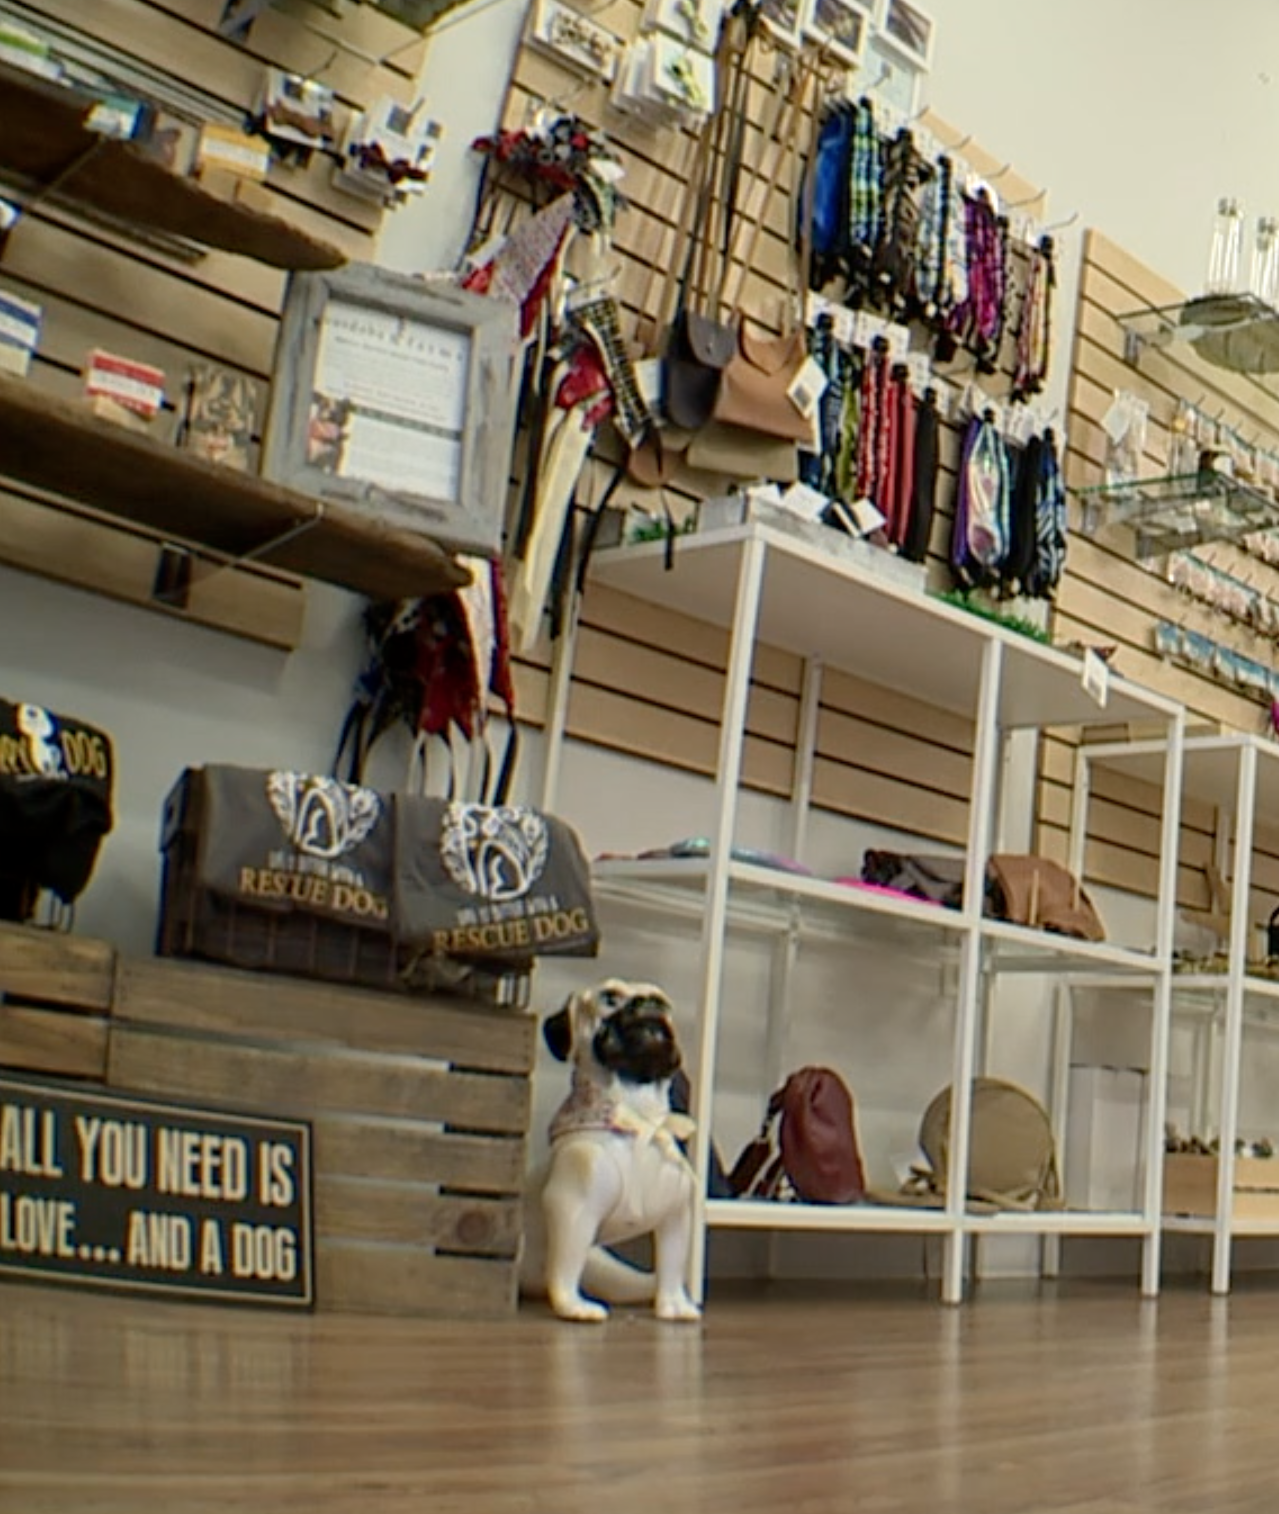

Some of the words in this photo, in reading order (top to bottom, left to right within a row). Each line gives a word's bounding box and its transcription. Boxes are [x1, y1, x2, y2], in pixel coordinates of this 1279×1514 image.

[61, 730, 108, 778] DOG
[240, 866, 330, 905] RESUE
[432, 918, 531, 956] RESCUE
[533, 906, 590, 941] DOG
[0, 1104, 63, 1178] ALL
[75, 1115, 147, 1189] YOU
[157, 1126, 247, 1201] NEED
[259, 1141, 294, 1207] IS
[0, 1192, 122, 1263] LOVE...
[127, 1210, 191, 1271] AND
[201, 1218, 223, 1275] A
[232, 1221, 297, 1281] DOG
